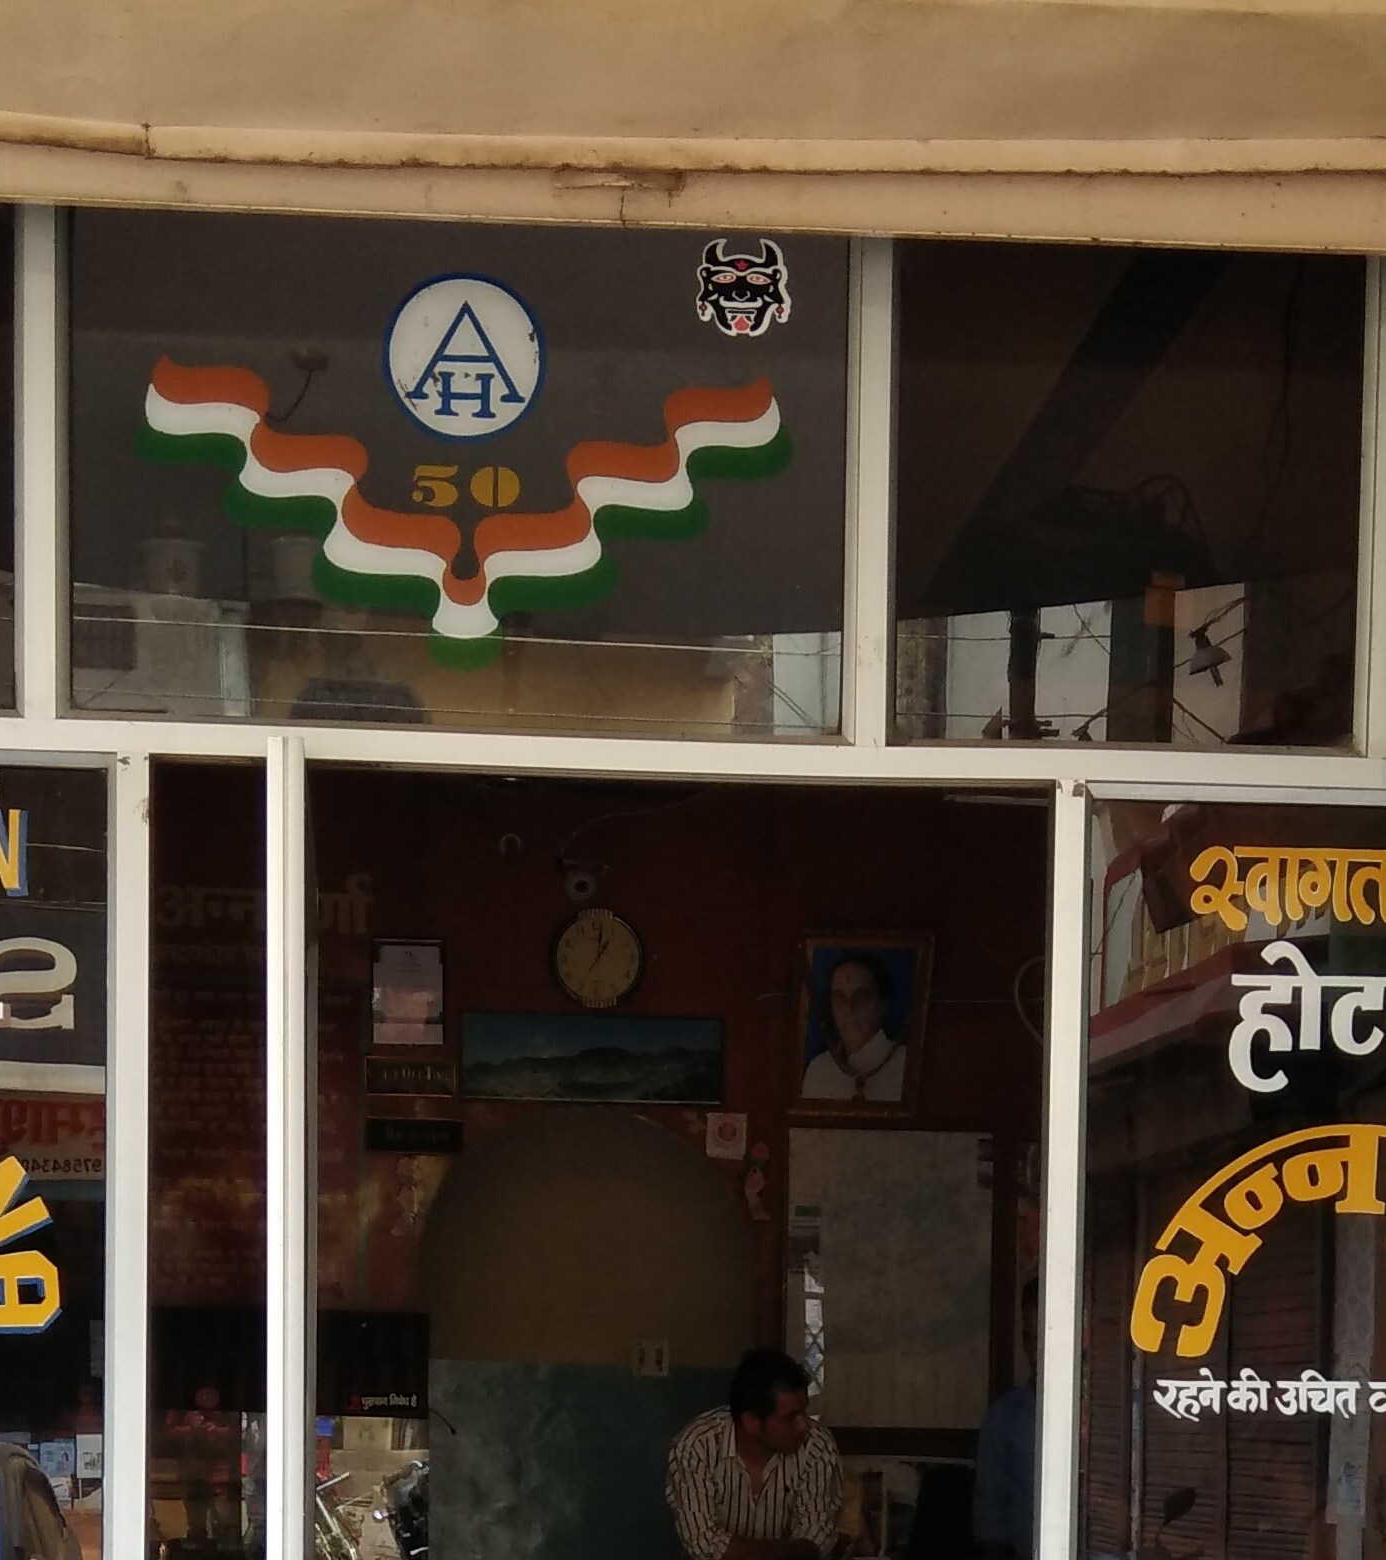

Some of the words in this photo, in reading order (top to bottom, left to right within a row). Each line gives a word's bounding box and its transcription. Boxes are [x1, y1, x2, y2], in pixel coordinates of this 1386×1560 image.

[412, 465, 521, 507] 50
[1153, 1367, 1227, 1421] रहने
[1226, 1367, 1272, 1413] की
[1274, 1369, 1361, 1419] उचित
